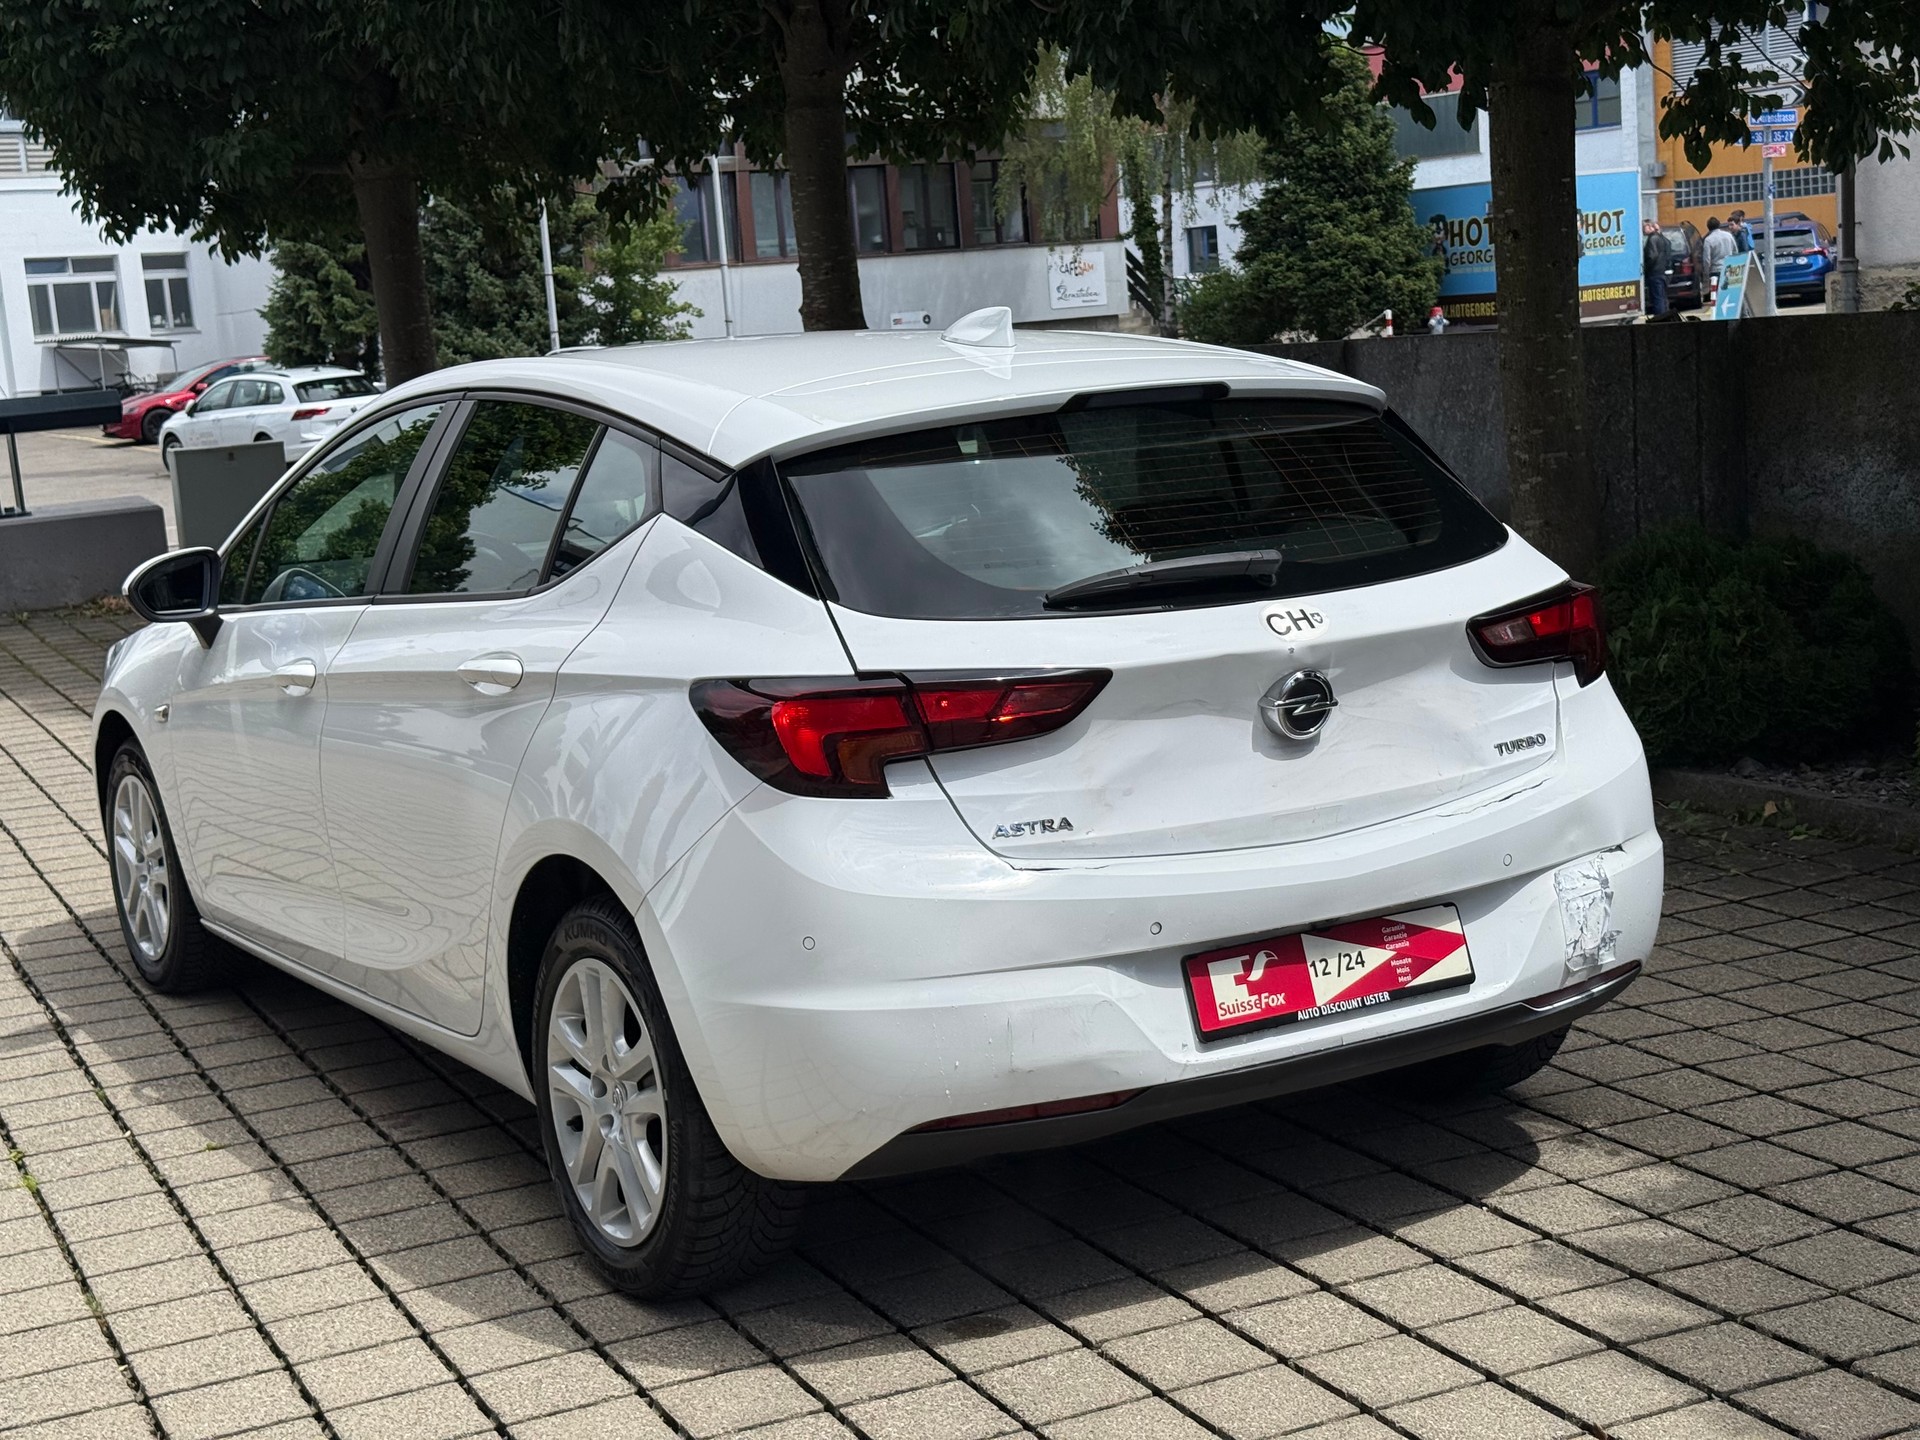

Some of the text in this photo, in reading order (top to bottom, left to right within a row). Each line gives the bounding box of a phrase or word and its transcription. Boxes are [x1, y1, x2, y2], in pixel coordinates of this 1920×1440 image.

[1585, 210, 1624, 235] HOT
[1584, 234, 1626, 249] GEORGE
[1451, 249, 1494, 267] GEORG
[1266, 609, 1316, 635] CH
[1493, 733, 1546, 757] TURBO
[991, 817, 1074, 840] ASTRA
[564, 922, 608, 947] KUMHO
[1381, 923, 1405, 933] Garantie
[1383, 932, 1408, 942] Garantie
[1385, 940, 1410, 950] Garanzia
[1390, 957, 1412, 967] Monate
[1396, 966, 1410, 975] Mois
[1398, 974, 1412, 983] Mesi
[1218, 992, 1286, 1017] SuisseFox
[1297, 991, 1391, 1021] AUTO DISCOUNT USTER
